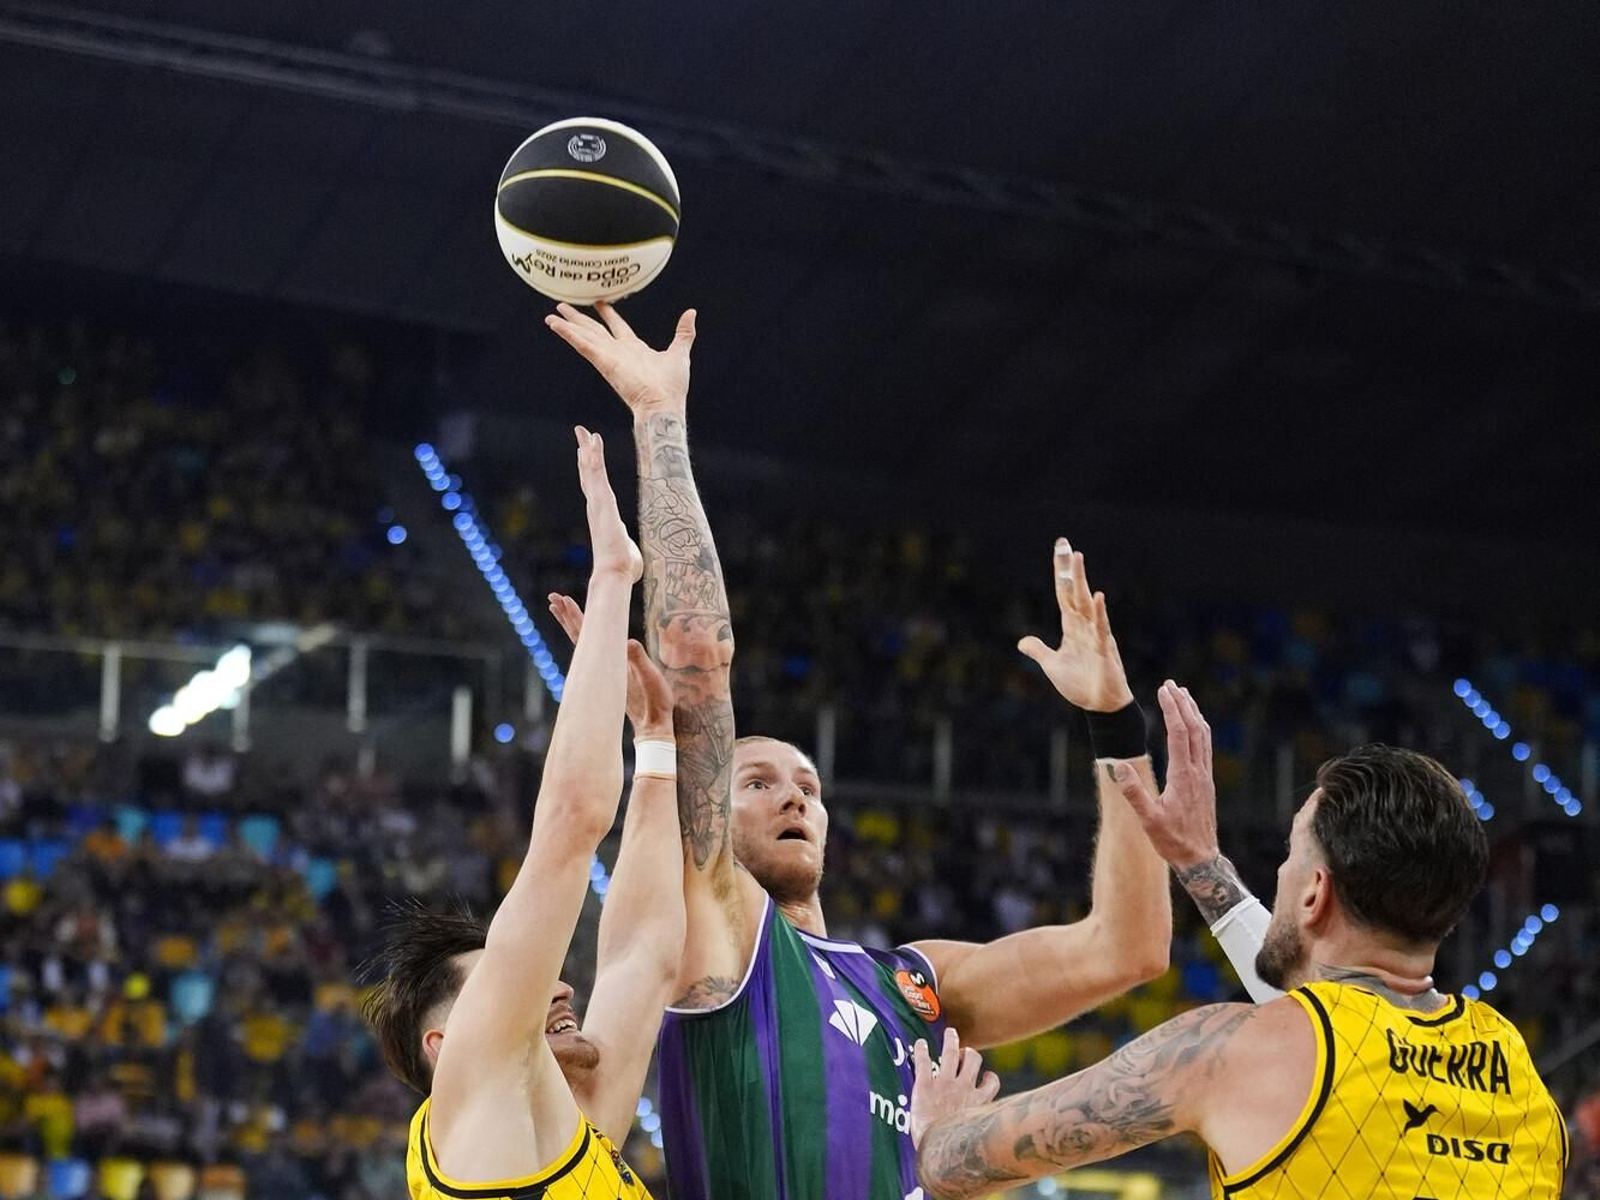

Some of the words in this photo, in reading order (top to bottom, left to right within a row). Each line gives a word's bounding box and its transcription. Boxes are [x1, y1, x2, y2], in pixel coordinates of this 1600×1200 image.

[525, 253, 556, 277] Rey
[560, 270, 583, 281] del
[587, 263, 641, 282] Copa
[1386, 1027, 1512, 1096] GUERRA
